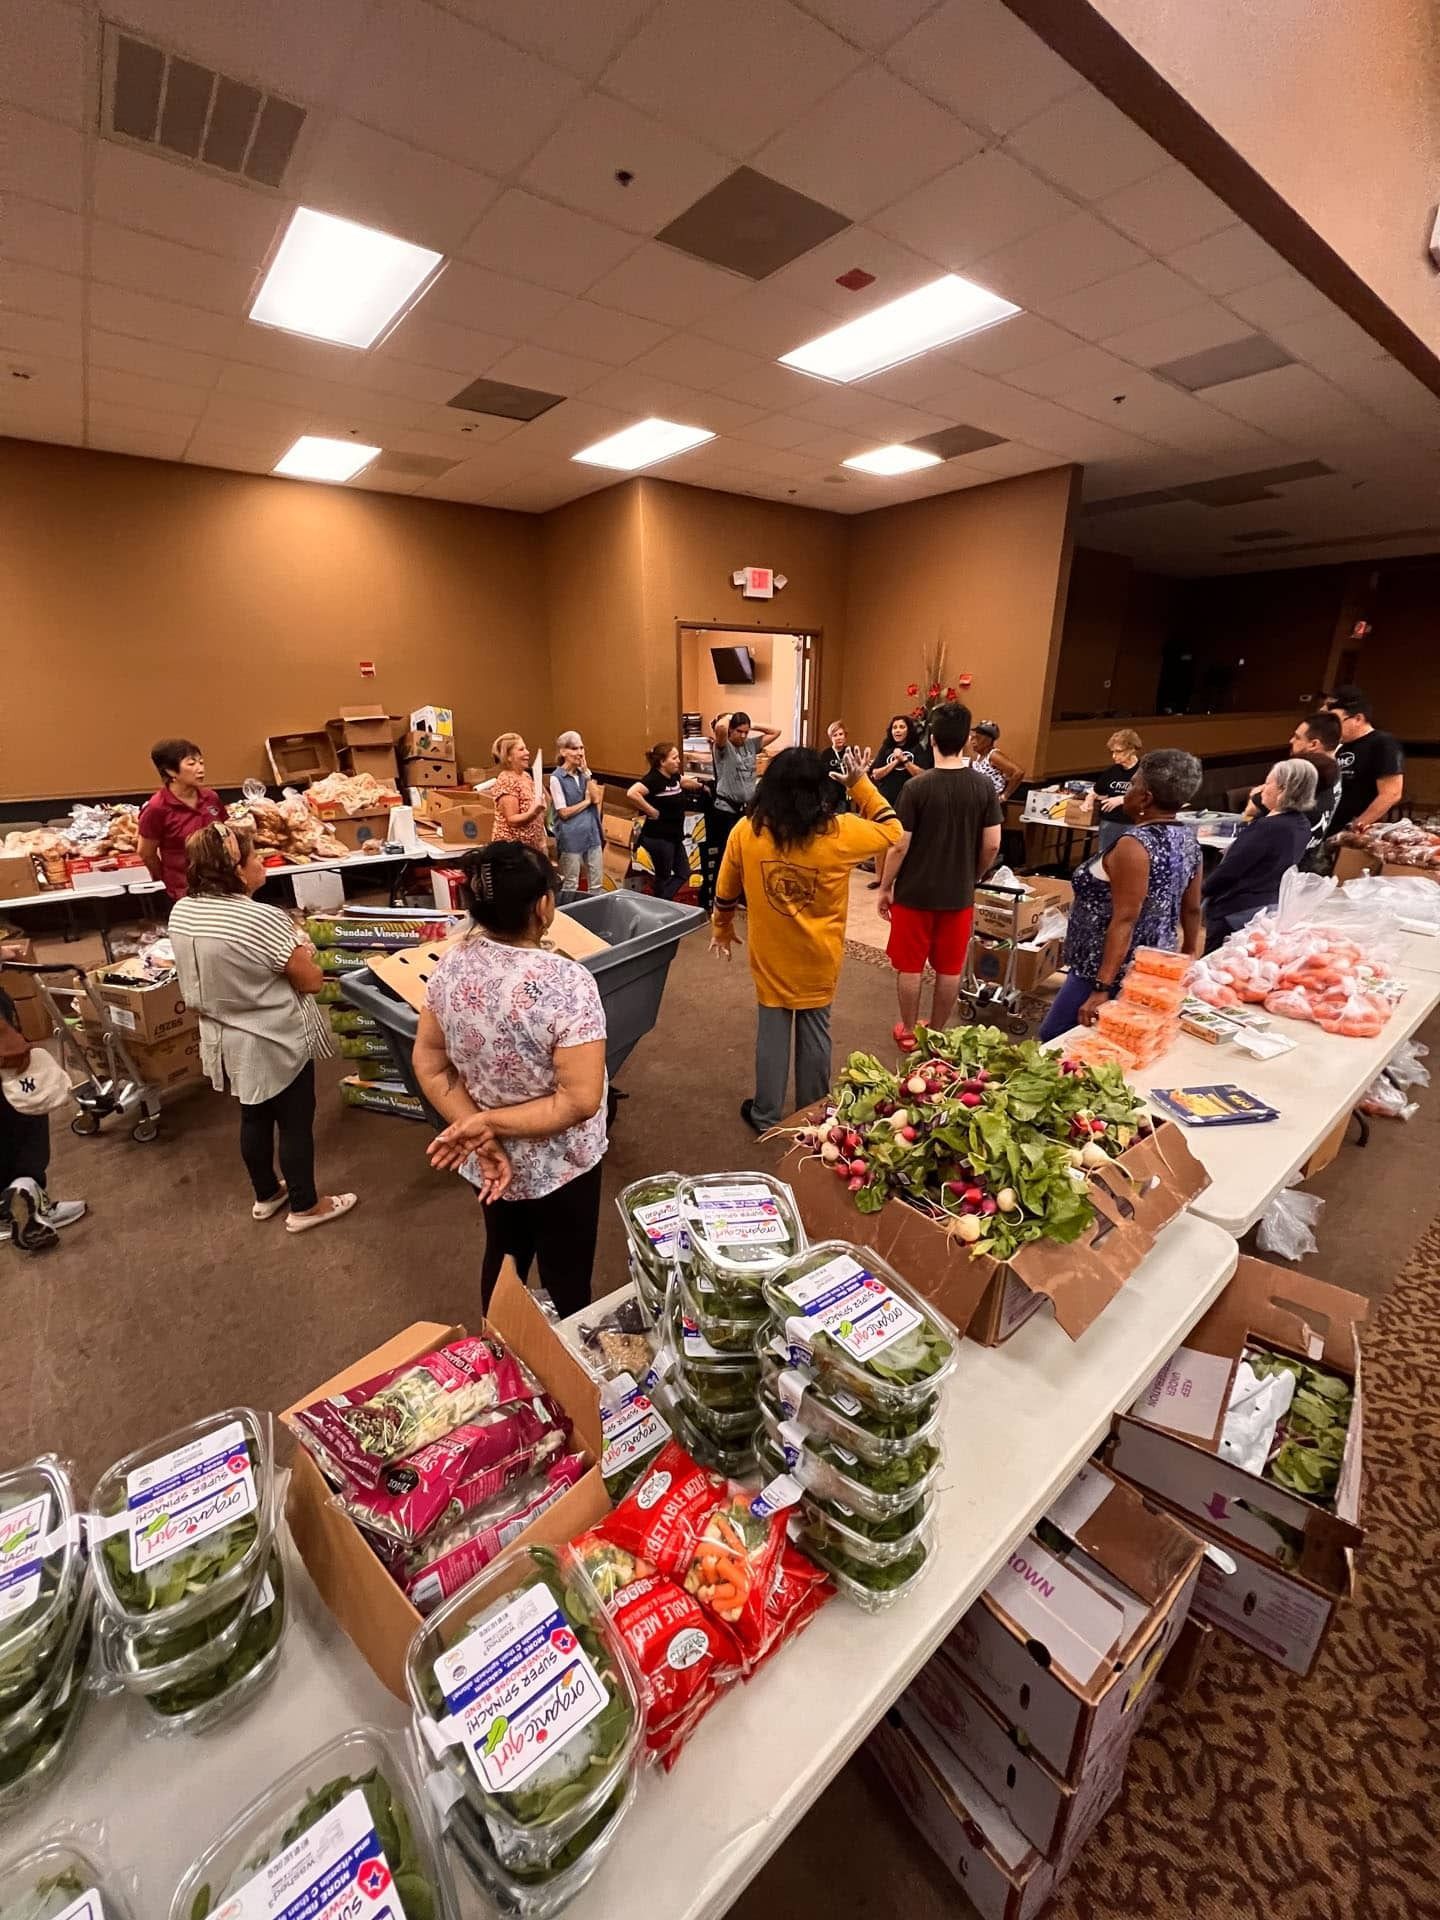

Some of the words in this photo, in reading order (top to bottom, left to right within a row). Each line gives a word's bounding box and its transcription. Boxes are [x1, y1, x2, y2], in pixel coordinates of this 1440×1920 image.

[334, 926, 373, 938] Sundale
[374, 926, 420, 940] Vineyards
[356, 1015, 376, 1026] Sun
[19, 1077, 36, 1093] NY
[853, 1291, 875, 1309] SUPER
[851, 1306, 903, 1349] organicgirl
[604, 1422, 657, 1466] organicgirl
[192, 1471, 229, 1496] SUPER
[135, 1490, 189, 1526] SPINACH!
[147, 1491, 241, 1554] organicgirl
[663, 1594, 701, 1624] TABLE
[514, 1642, 522, 1652] C
[524, 1635, 546, 1657] MORE
[473, 1667, 503, 1694] calcium
[494, 1647, 551, 1695] POWERHOUSE
[521, 1651, 558, 1687] SUPER
[464, 1690, 493, 1720] BLEND
[466, 1683, 520, 1736] SPINACH!
[491, 1679, 585, 1776] organicgirl
[354, 1837, 371, 1859] and
[319, 1854, 353, 1888] vitamin
[319, 1870, 351, 1902] MORE
[287, 1893, 310, 1917] than
[310, 1886, 319, 1898] C
